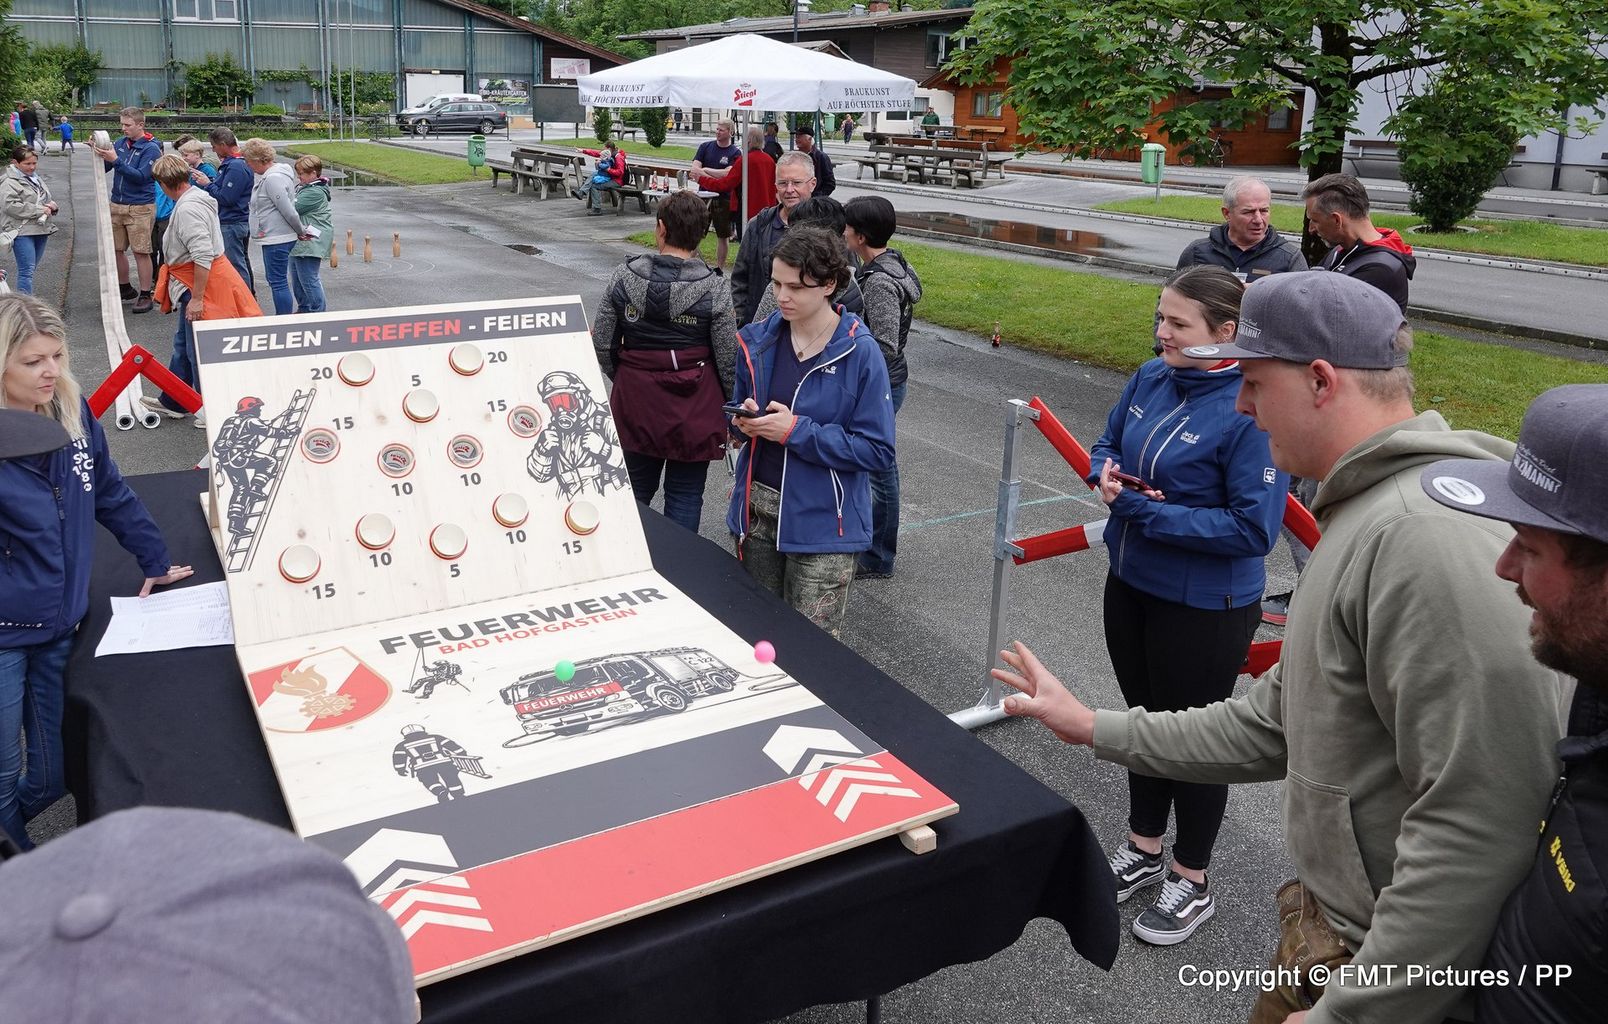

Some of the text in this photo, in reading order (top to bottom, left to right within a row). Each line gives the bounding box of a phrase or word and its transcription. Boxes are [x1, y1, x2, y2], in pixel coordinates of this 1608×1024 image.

[600, 84, 645, 92] BRAUKUNST
[734, 89, 756, 102] Stiegl
[844, 87, 890, 96] BRAUKUNST
[594, 94, 634, 104] HÖCHSTER
[636, 95, 664, 104] STUFE
[827, 98, 911, 110] AUF HÖCHSTER STUFE
[222, 329, 322, 354] ZIELEN
[347, 319, 462, 344] TREFFEN
[483, 311, 567, 332] FEIERN
[487, 350, 508, 364] 20
[310, 367, 333, 381] 20
[411, 374, 422, 387] 5
[487, 399, 508, 413] 15
[332, 416, 355, 431] 15
[460, 472, 482, 487] 10
[391, 482, 414, 497] 10
[505, 529, 527, 545] 10
[562, 540, 583, 555] 15
[369, 551, 393, 568] 10
[450, 564, 461, 578] 5
[312, 583, 336, 600] 15
[379, 587, 668, 655] FEUERWEHR
[438, 608, 638, 655] BAD HOFGASTEIN
[523, 687, 607, 711] FEUERWEHR
